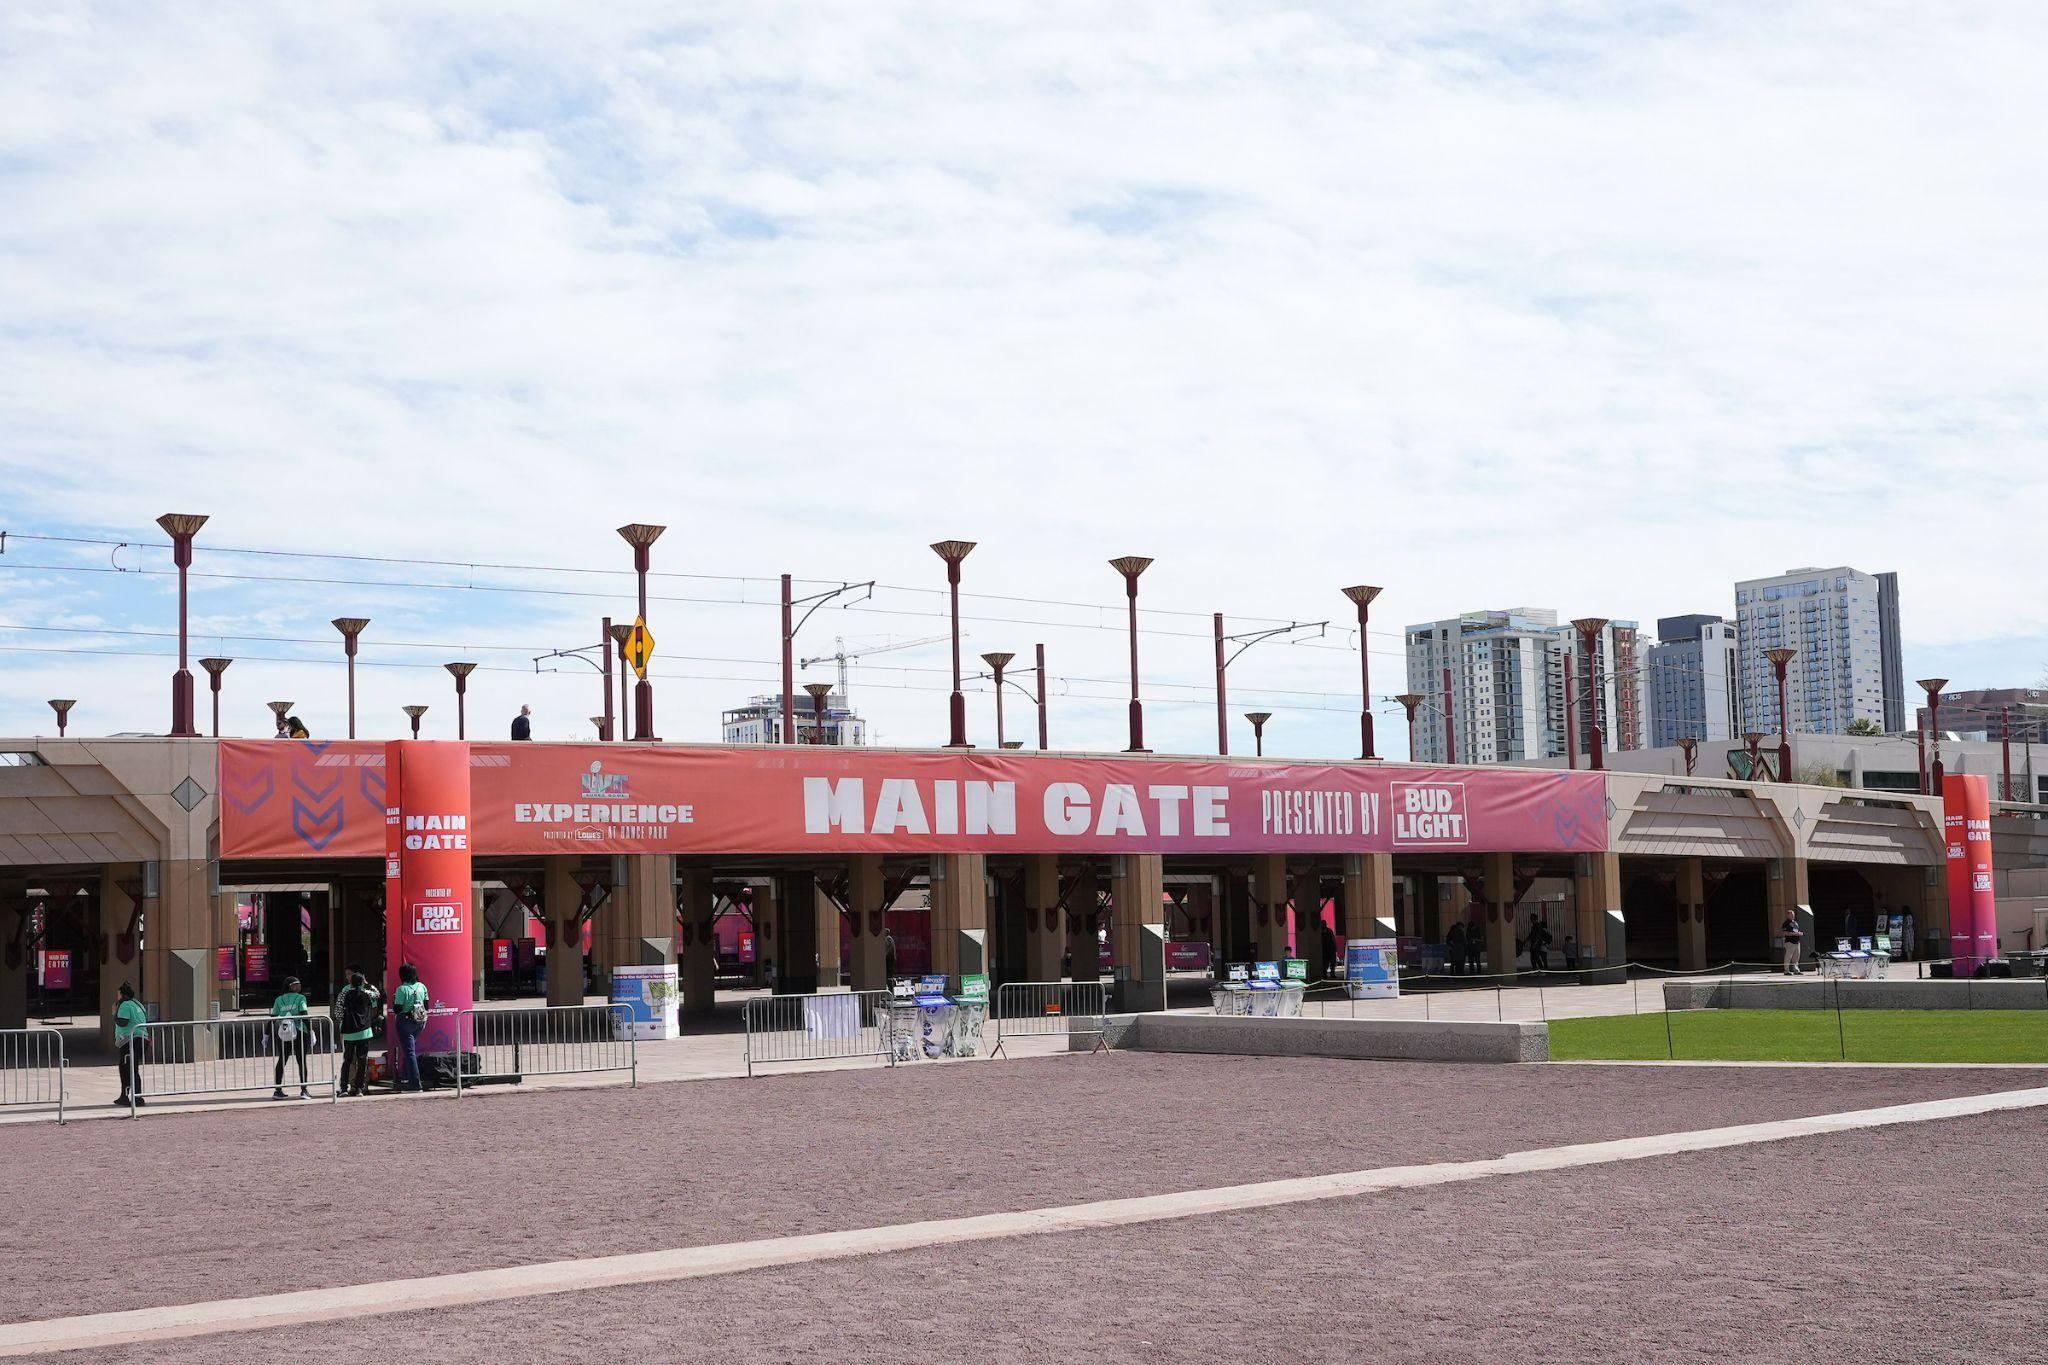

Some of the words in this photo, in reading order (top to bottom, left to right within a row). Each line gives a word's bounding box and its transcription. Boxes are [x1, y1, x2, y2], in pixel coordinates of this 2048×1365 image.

[803, 777, 1017, 835] MAIN
[1044, 782, 1231, 837] GATE
[1405, 788, 1453, 813] BUD
[514, 803, 694, 823] EXPERIENCE
[1262, 790, 1353, 835] PRESENTED
[1360, 792, 1380, 835] BY
[405, 815, 466, 830] MAIN
[1397, 813, 1464, 839] LIGHT
[1967, 819, 1990, 830] MAIN
[608, 825, 616, 839] AT
[648, 825, 668, 840] PARK
[1967, 831, 1990, 841] GATE
[405, 834, 467, 850] GATE
[422, 906, 455, 918] BUD
[415, 918, 460, 931] LIGHT
[48, 960, 70, 969] ENTRY
